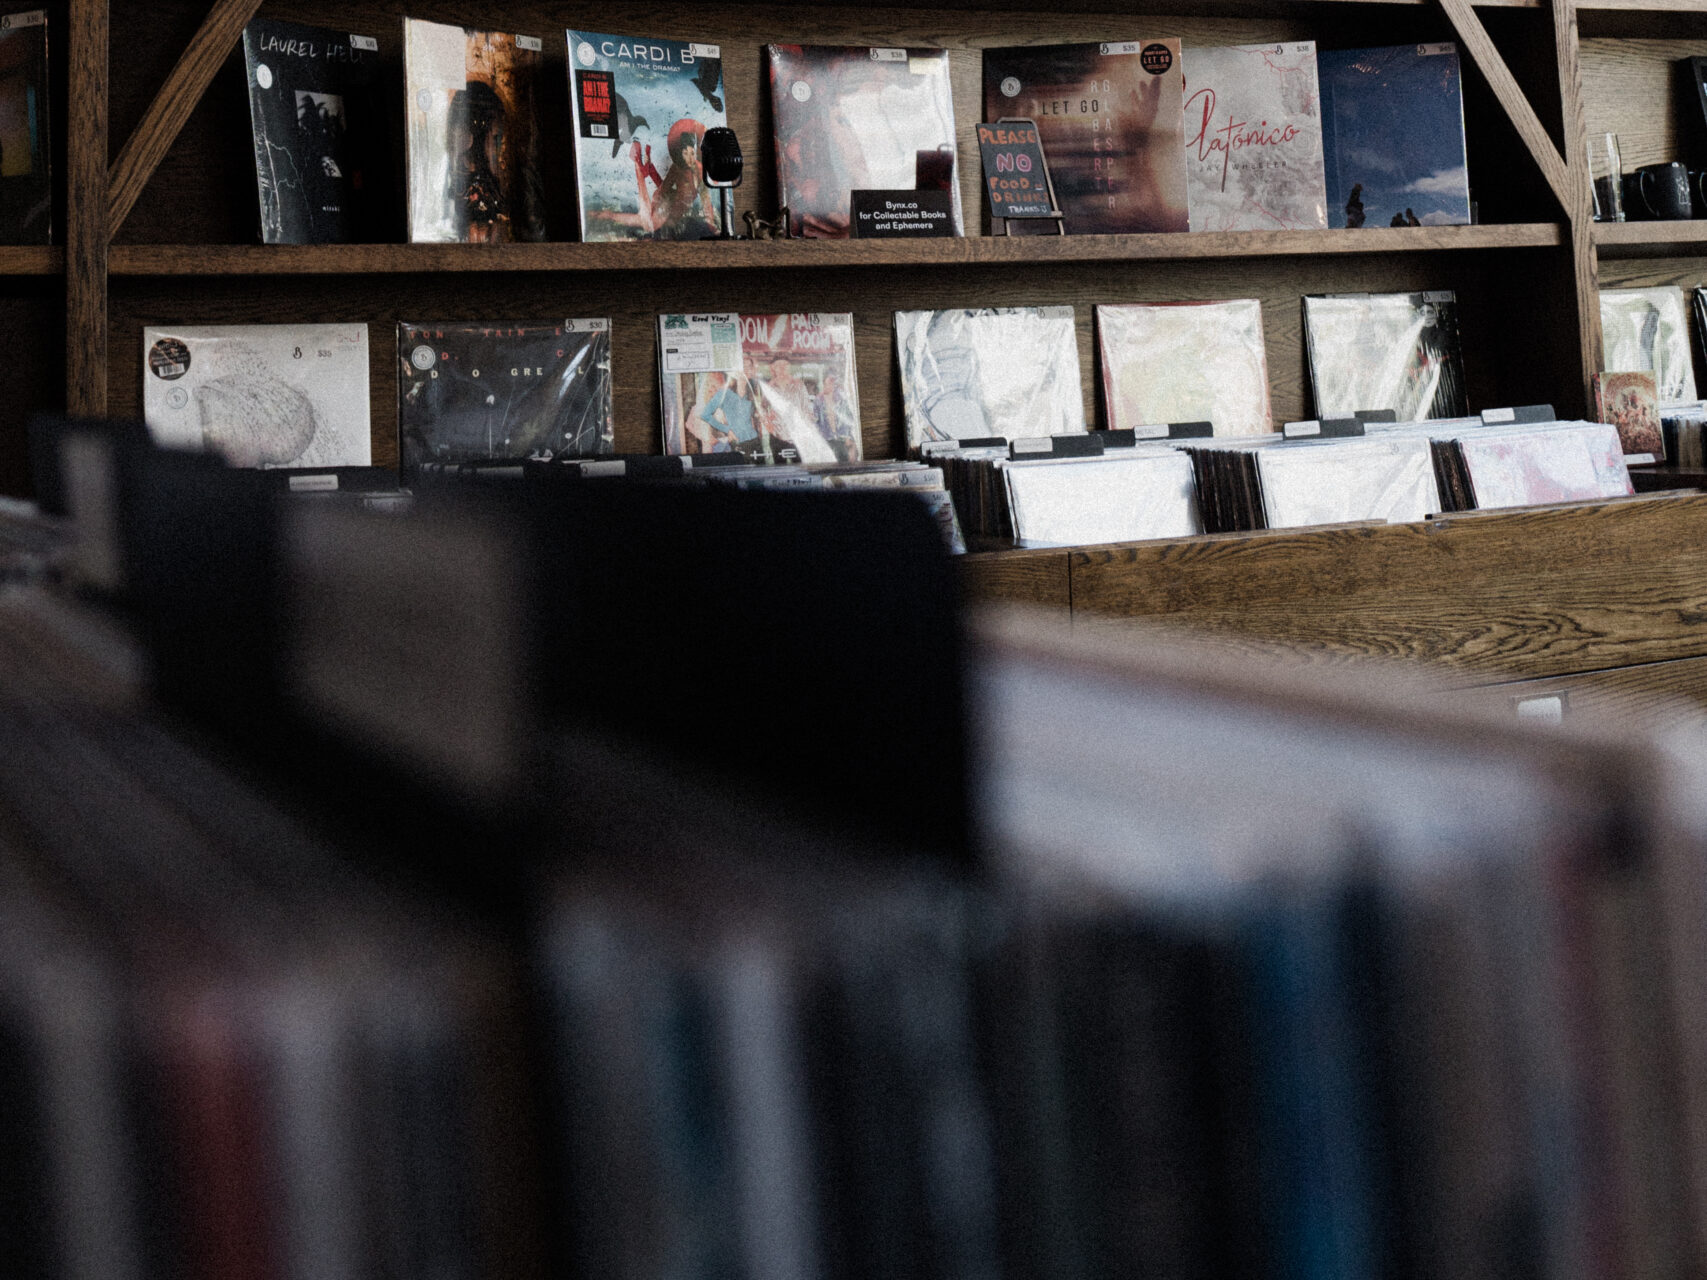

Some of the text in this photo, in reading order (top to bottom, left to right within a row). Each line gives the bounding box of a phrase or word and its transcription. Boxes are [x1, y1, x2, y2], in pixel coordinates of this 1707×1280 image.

[259, 32, 318, 59] LAUREL
[601, 42, 695, 64] CARDI B
[1143, 56, 1157, 65] LET
[619, 62, 631, 70] AM
[637, 63, 651, 71] THE
[652, 65, 681, 73] DRAMA?
[1042, 99, 1099, 115] LET GO
[979, 127, 1036, 145] PLEASE
[996, 153, 1032, 172] NO
[990, 176, 1030, 190] FOOD
[992, 191, 1049, 204] DRINKS
[886, 201, 918, 210] Bynx.co
[873, 211, 919, 219] Collectable
[921, 211, 946, 219] Books
[875, 222, 933, 231] and Ephemera
[590, 321, 603, 329] $30
[711, 315, 730, 324] Vinyl
[793, 329, 832, 349] ROOM
[511, 367, 544, 378] GRE
